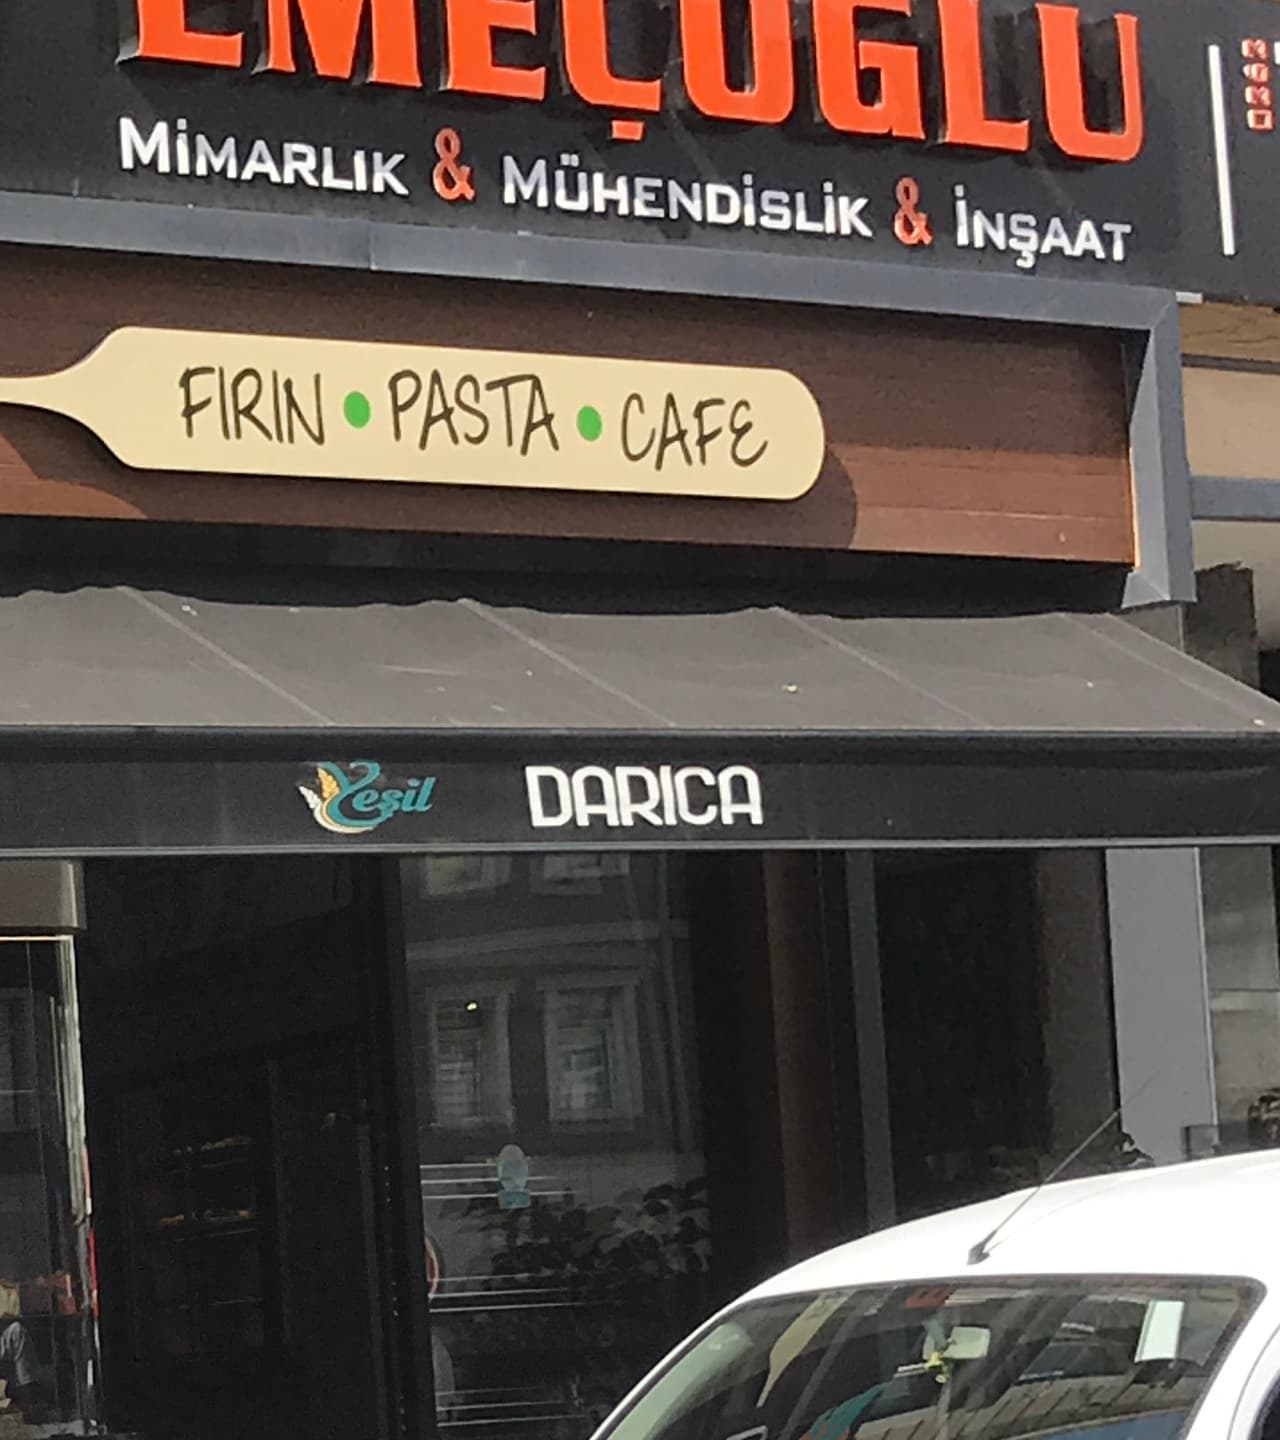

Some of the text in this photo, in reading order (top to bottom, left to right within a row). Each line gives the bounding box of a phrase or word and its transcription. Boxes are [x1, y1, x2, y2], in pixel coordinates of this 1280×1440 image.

[432, 127, 475, 201] &
[892, 176, 934, 246] &
[954, 184, 1132, 269] İNŞAAT
[178, 365, 770, 471] FIRIN PASTA CAFE
[524, 764, 765, 828] DARICA
